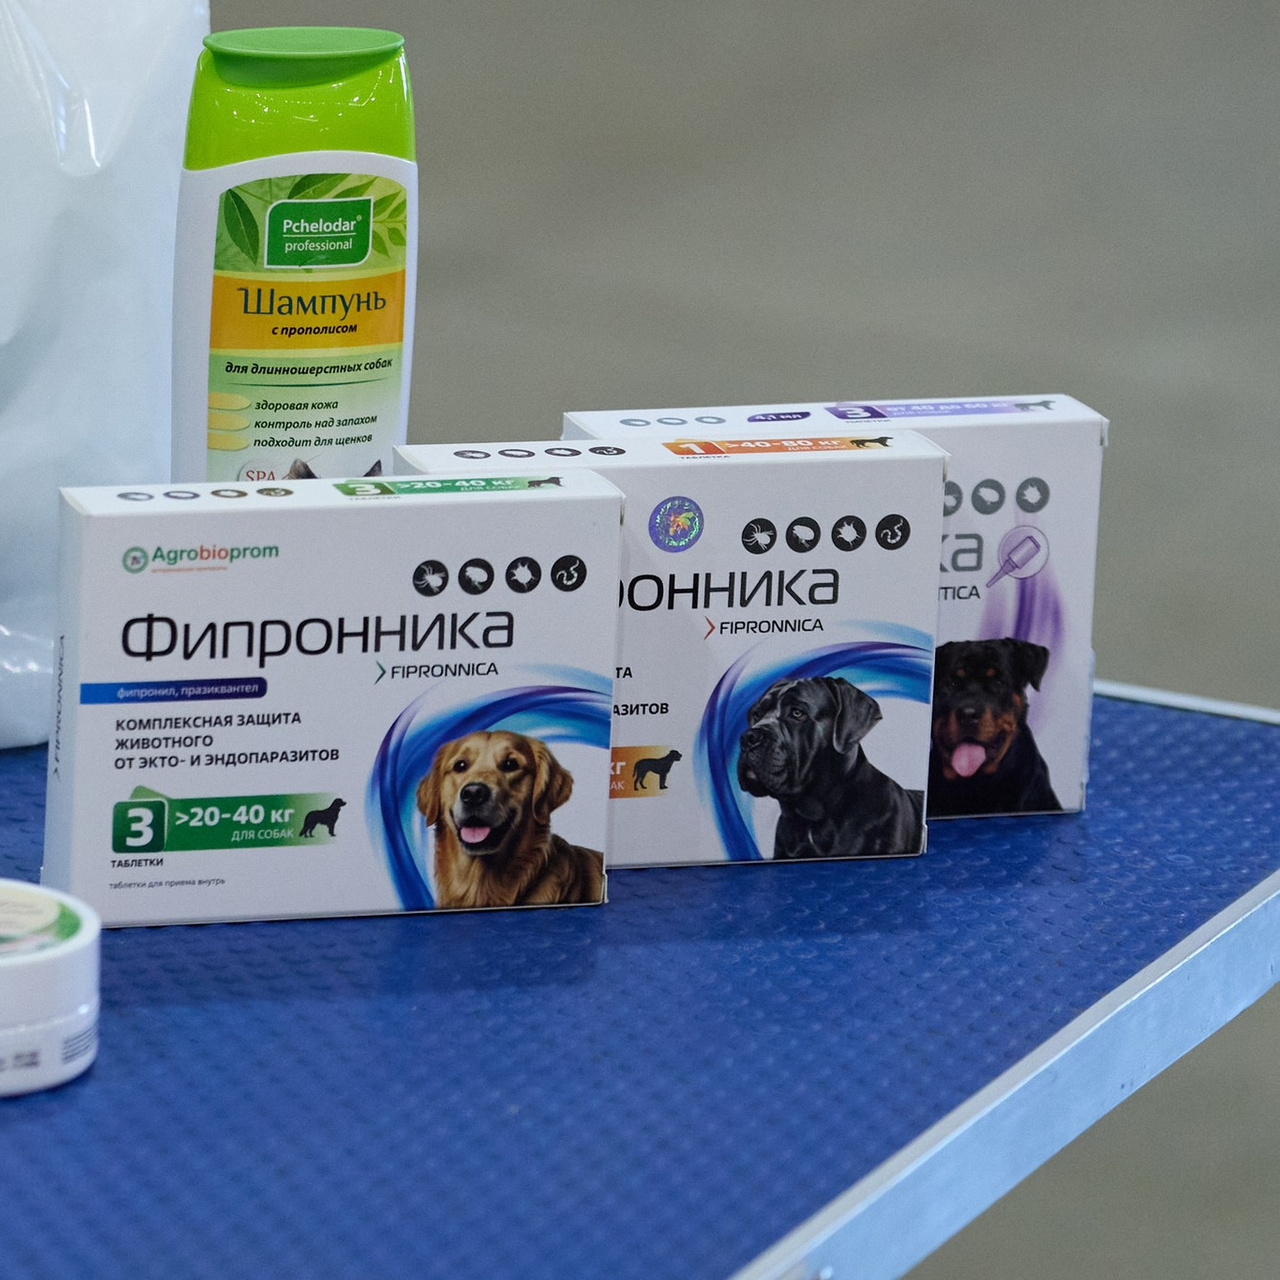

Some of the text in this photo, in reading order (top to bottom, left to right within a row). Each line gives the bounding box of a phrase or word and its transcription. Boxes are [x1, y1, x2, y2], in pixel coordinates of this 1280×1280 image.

[284, 238, 353, 253] professional
[237, 287, 387, 322] Шампунь
[271, 323, 358, 338] с прополисом
[224, 357, 393, 377] для длинношерстных собак
[254, 399, 339, 412] здоровая кожа
[837, 407, 872, 418] 3
[254, 414, 378, 431] контроль над запахом
[253, 433, 373, 448] подходит для щенков
[678, 443, 706, 455] 1
[347, 483, 382, 495] 3
[151, 544, 280, 566] Agrobioprom
[720, 618, 825, 635] FIPRONNICA
[121, 611, 515, 669] Фипронника
[390, 661, 499, 680] FIPRONNICA
[116, 682, 259, 700] фипронил, празиквантел
[115, 712, 302, 732] КОМПЛЕКСНАЯ ЗАЩИТА
[114, 734, 214, 751] ЖИВОТНОГО
[114, 748, 340, 770] ОТ ЭКТО- И ЭНДОПАРАЗИТОВ
[270, 808, 296, 824] кг
[124, 806, 155, 847] 3
[231, 828, 294, 842] ДЛЯ СОБАК
[111, 858, 164, 869] ТАБЛЕТКИ
[108, 878, 226, 890] таблетки для приема внутрь
